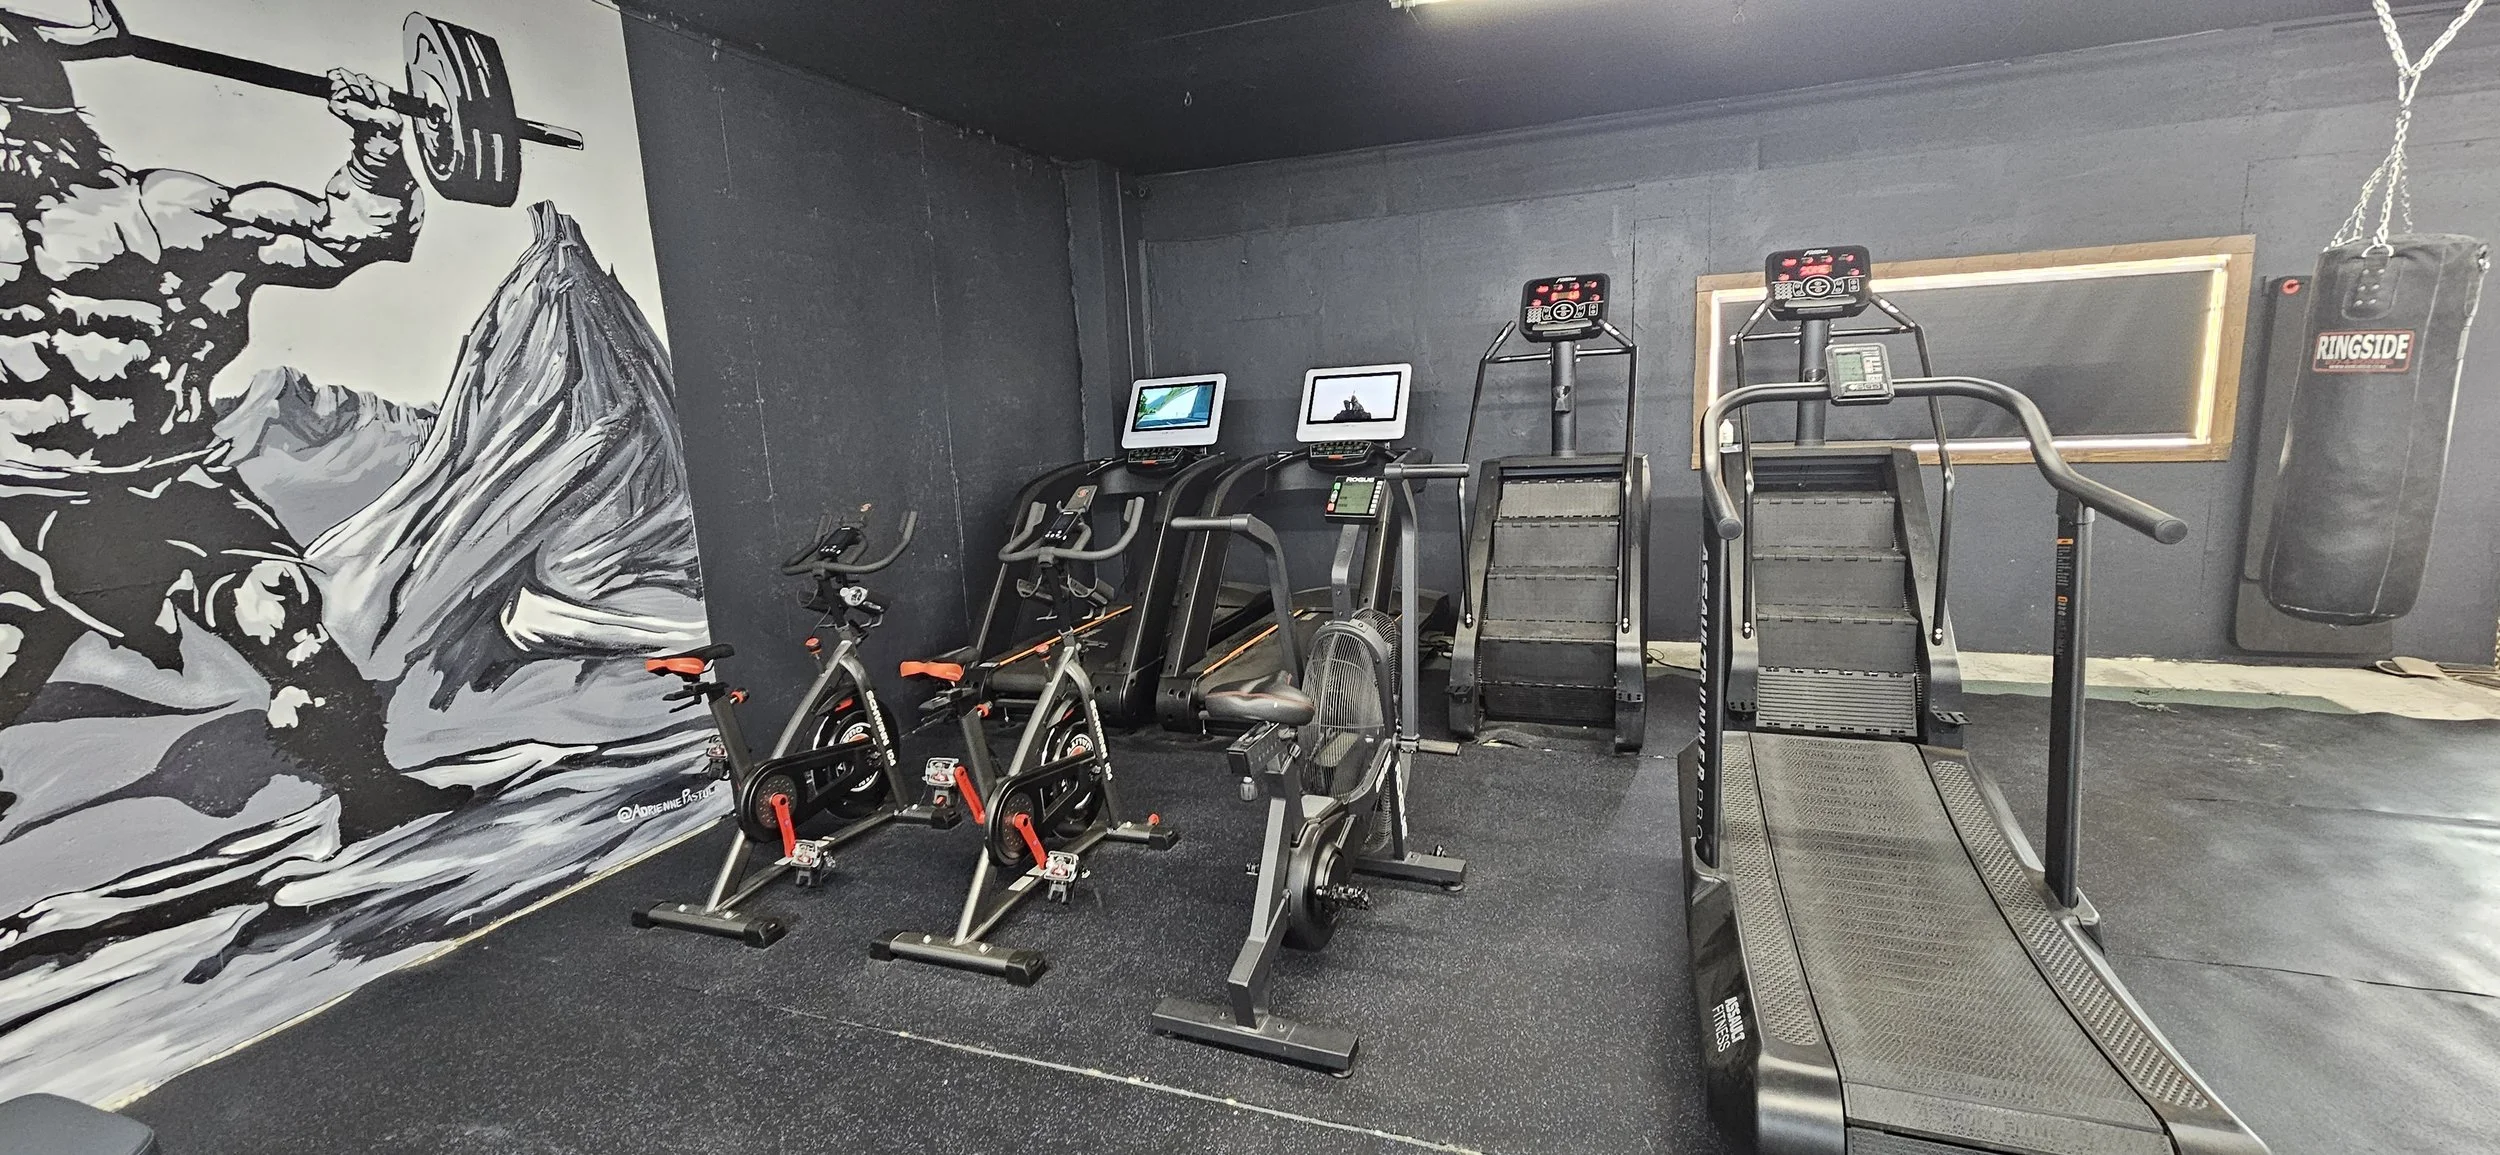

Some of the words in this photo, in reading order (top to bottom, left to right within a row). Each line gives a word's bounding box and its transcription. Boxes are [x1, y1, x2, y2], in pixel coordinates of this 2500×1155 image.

[2316, 334, 2410, 360] RINGSIDE
[865, 689, 890, 746] SCHWINN
[1089, 698, 1109, 760] SCHWINN
[1696, 787, 1705, 840] PRO
[1712, 1003, 1731, 1053] FITNESS
[1724, 996, 1746, 1043] ASSAULT
